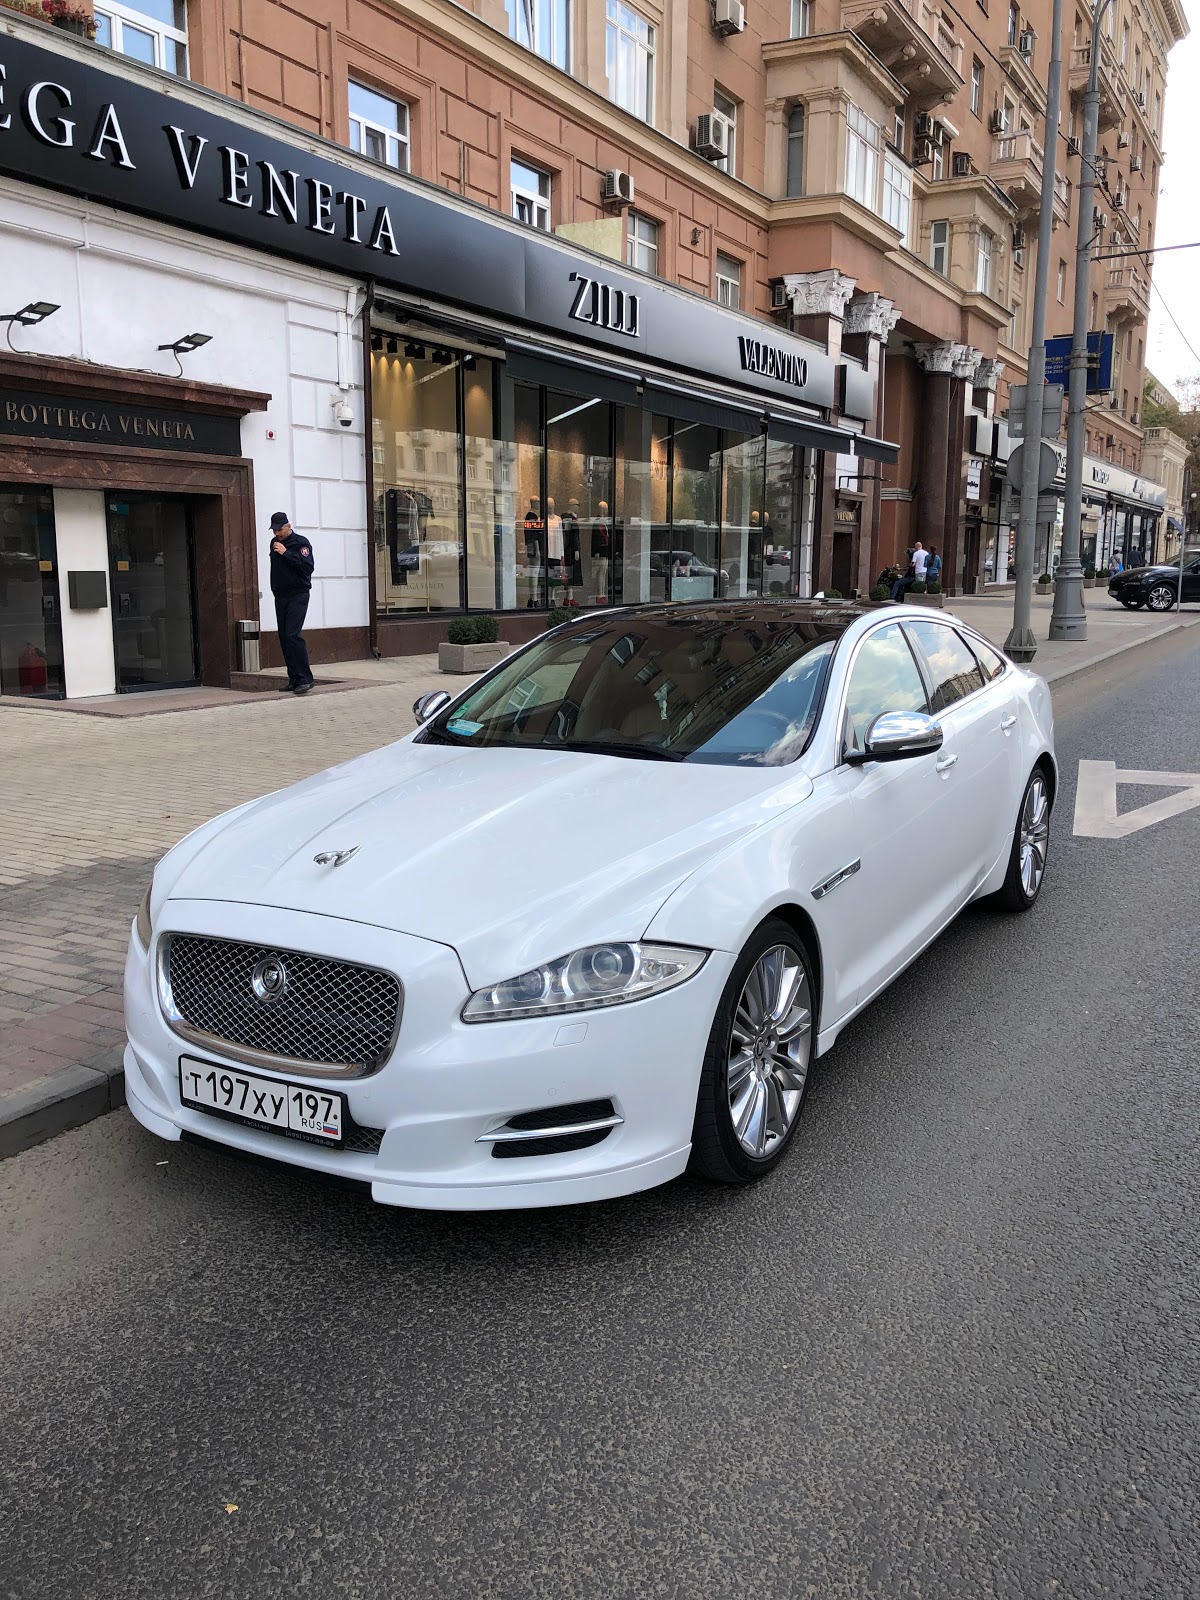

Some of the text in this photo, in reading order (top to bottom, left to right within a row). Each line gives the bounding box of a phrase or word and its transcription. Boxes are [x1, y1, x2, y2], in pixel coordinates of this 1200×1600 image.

[163, 125, 401, 256] VENETA
[570, 272, 641, 338] ZILLI
[738, 335, 809, 388] VALENTINO
[6, 401, 195, 441] BOTTEGA VENETA
[241, 1119, 270, 1131] JAGUAR
[292, 1091, 333, 1122] 197
[301, 1117, 323, 1131] RUS
